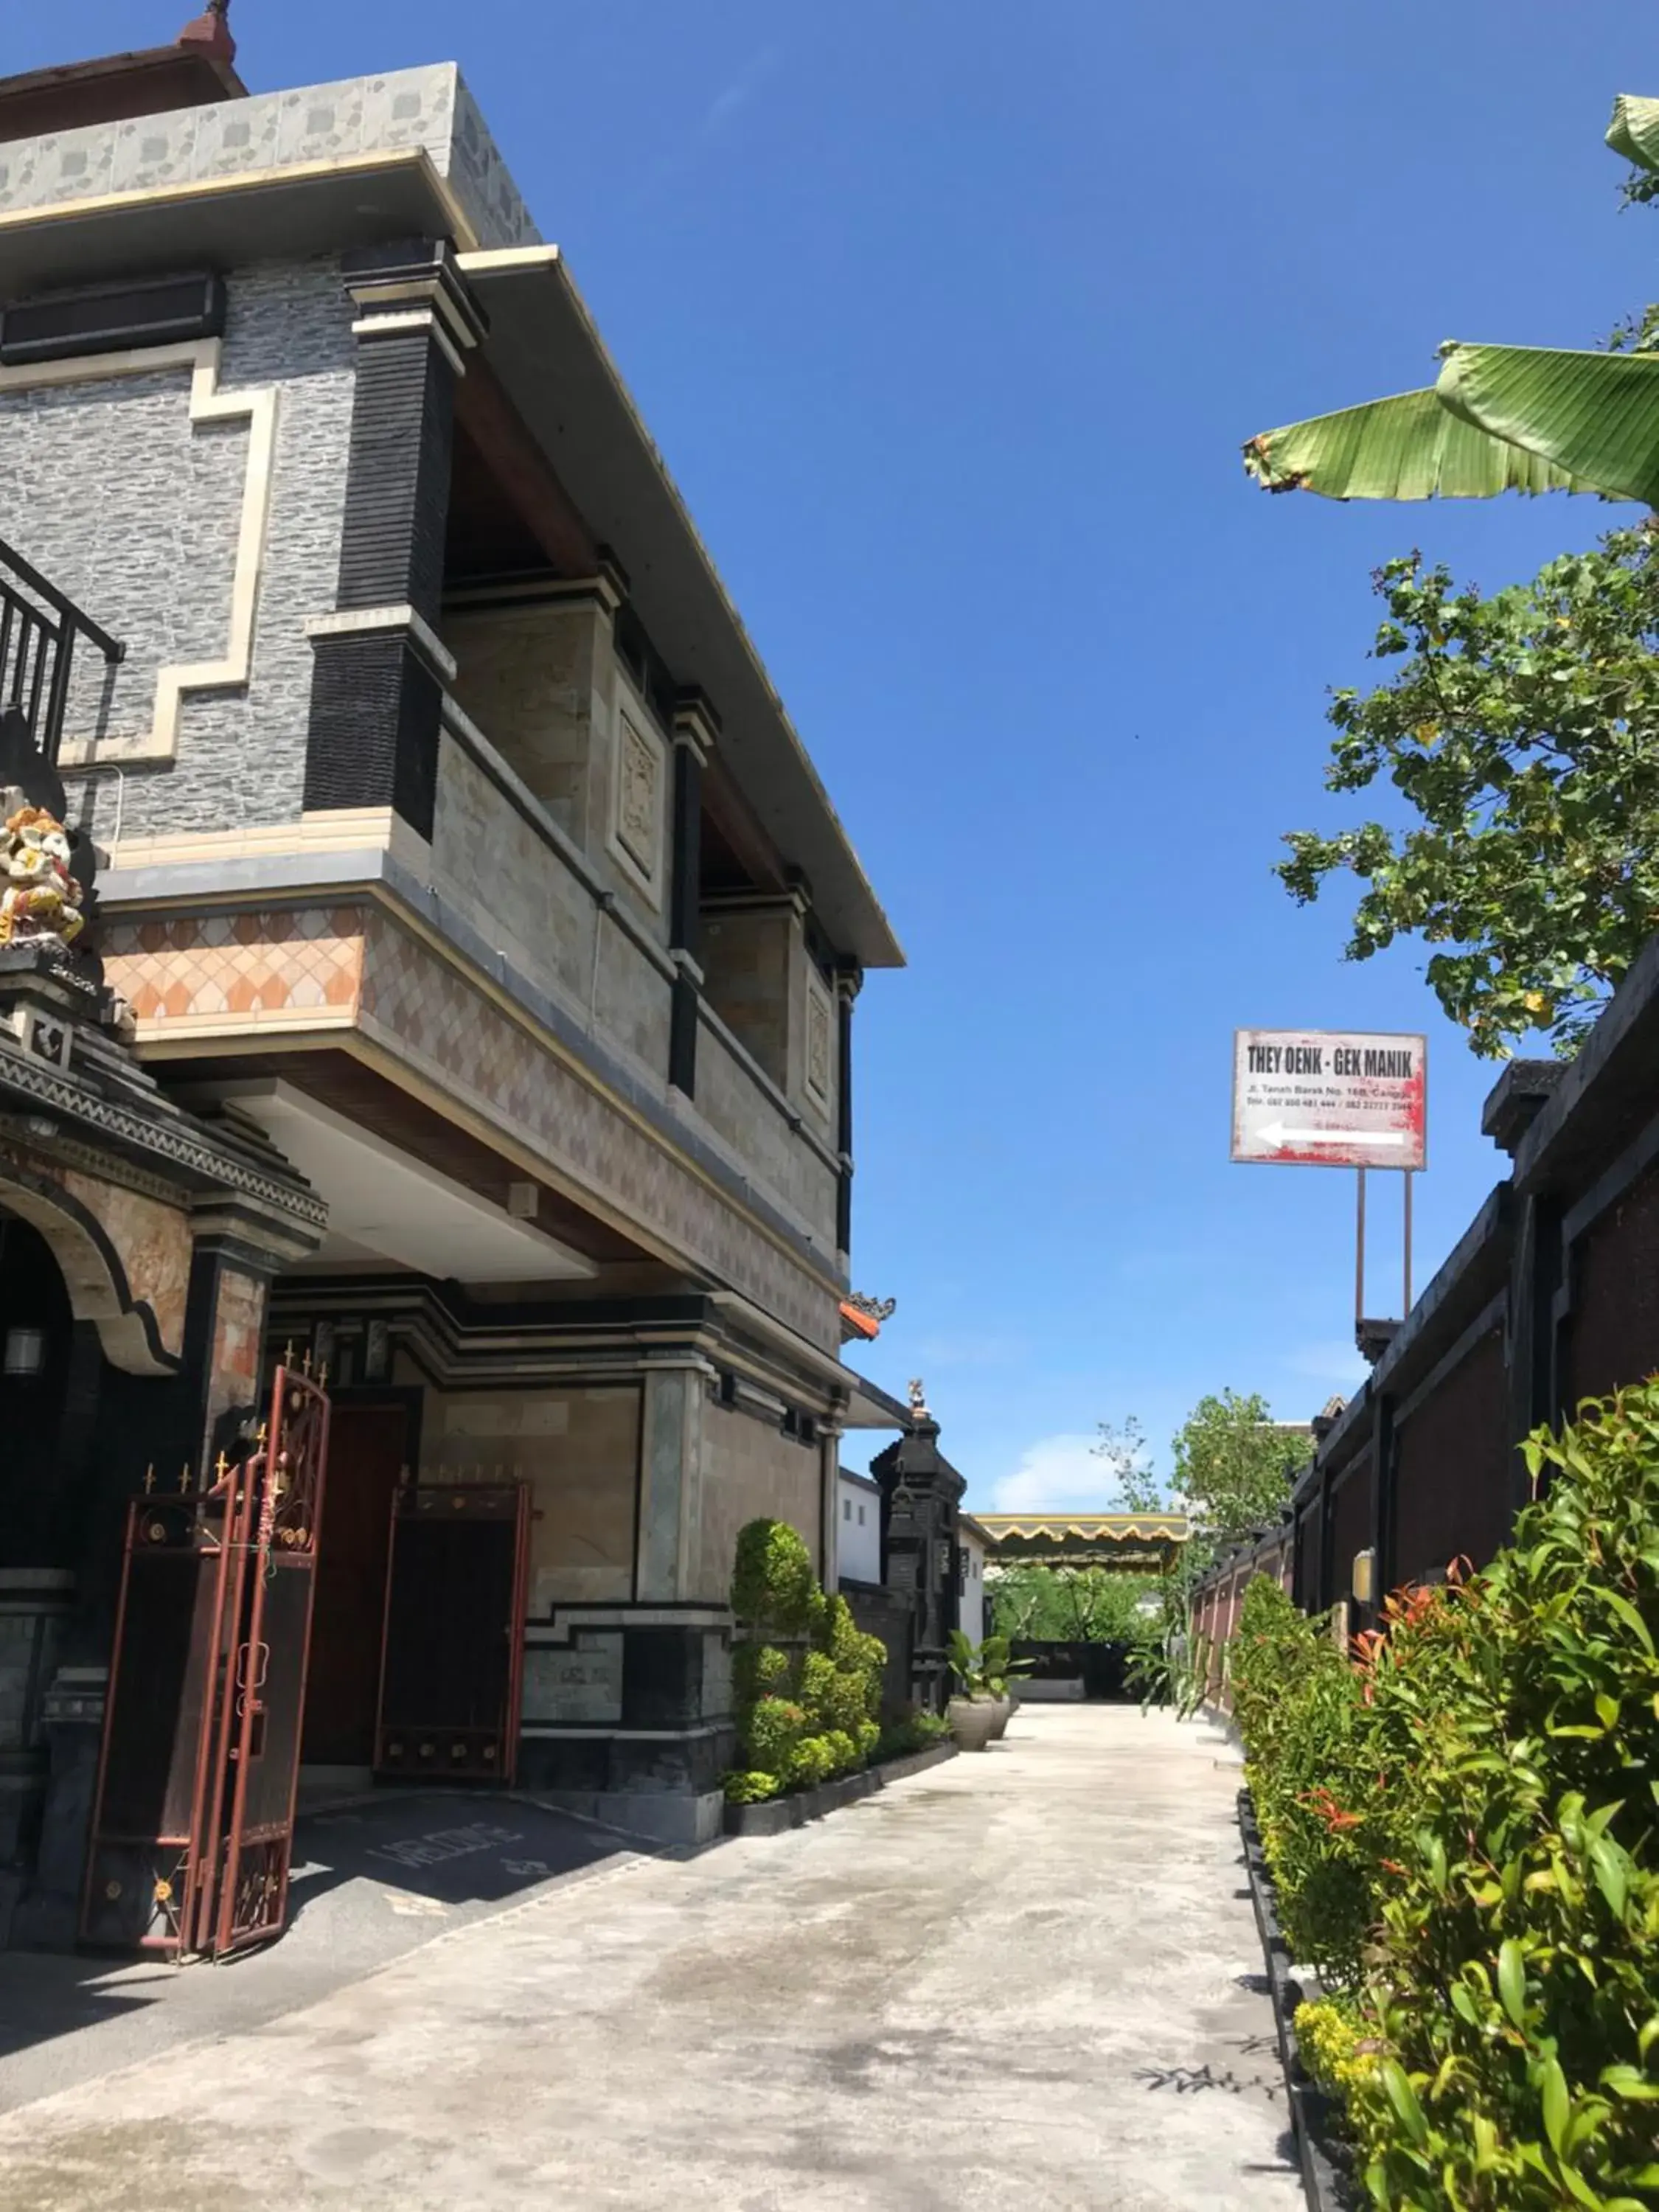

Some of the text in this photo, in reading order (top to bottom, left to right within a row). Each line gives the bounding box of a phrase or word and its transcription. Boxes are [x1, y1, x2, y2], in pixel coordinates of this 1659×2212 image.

[1248, 1046, 1282, 1074] THEY
[1285, 1047, 1322, 1074] OENK
[1334, 1048, 1361, 1077] GEK
[1365, 1049, 1412, 1078] MANIK
